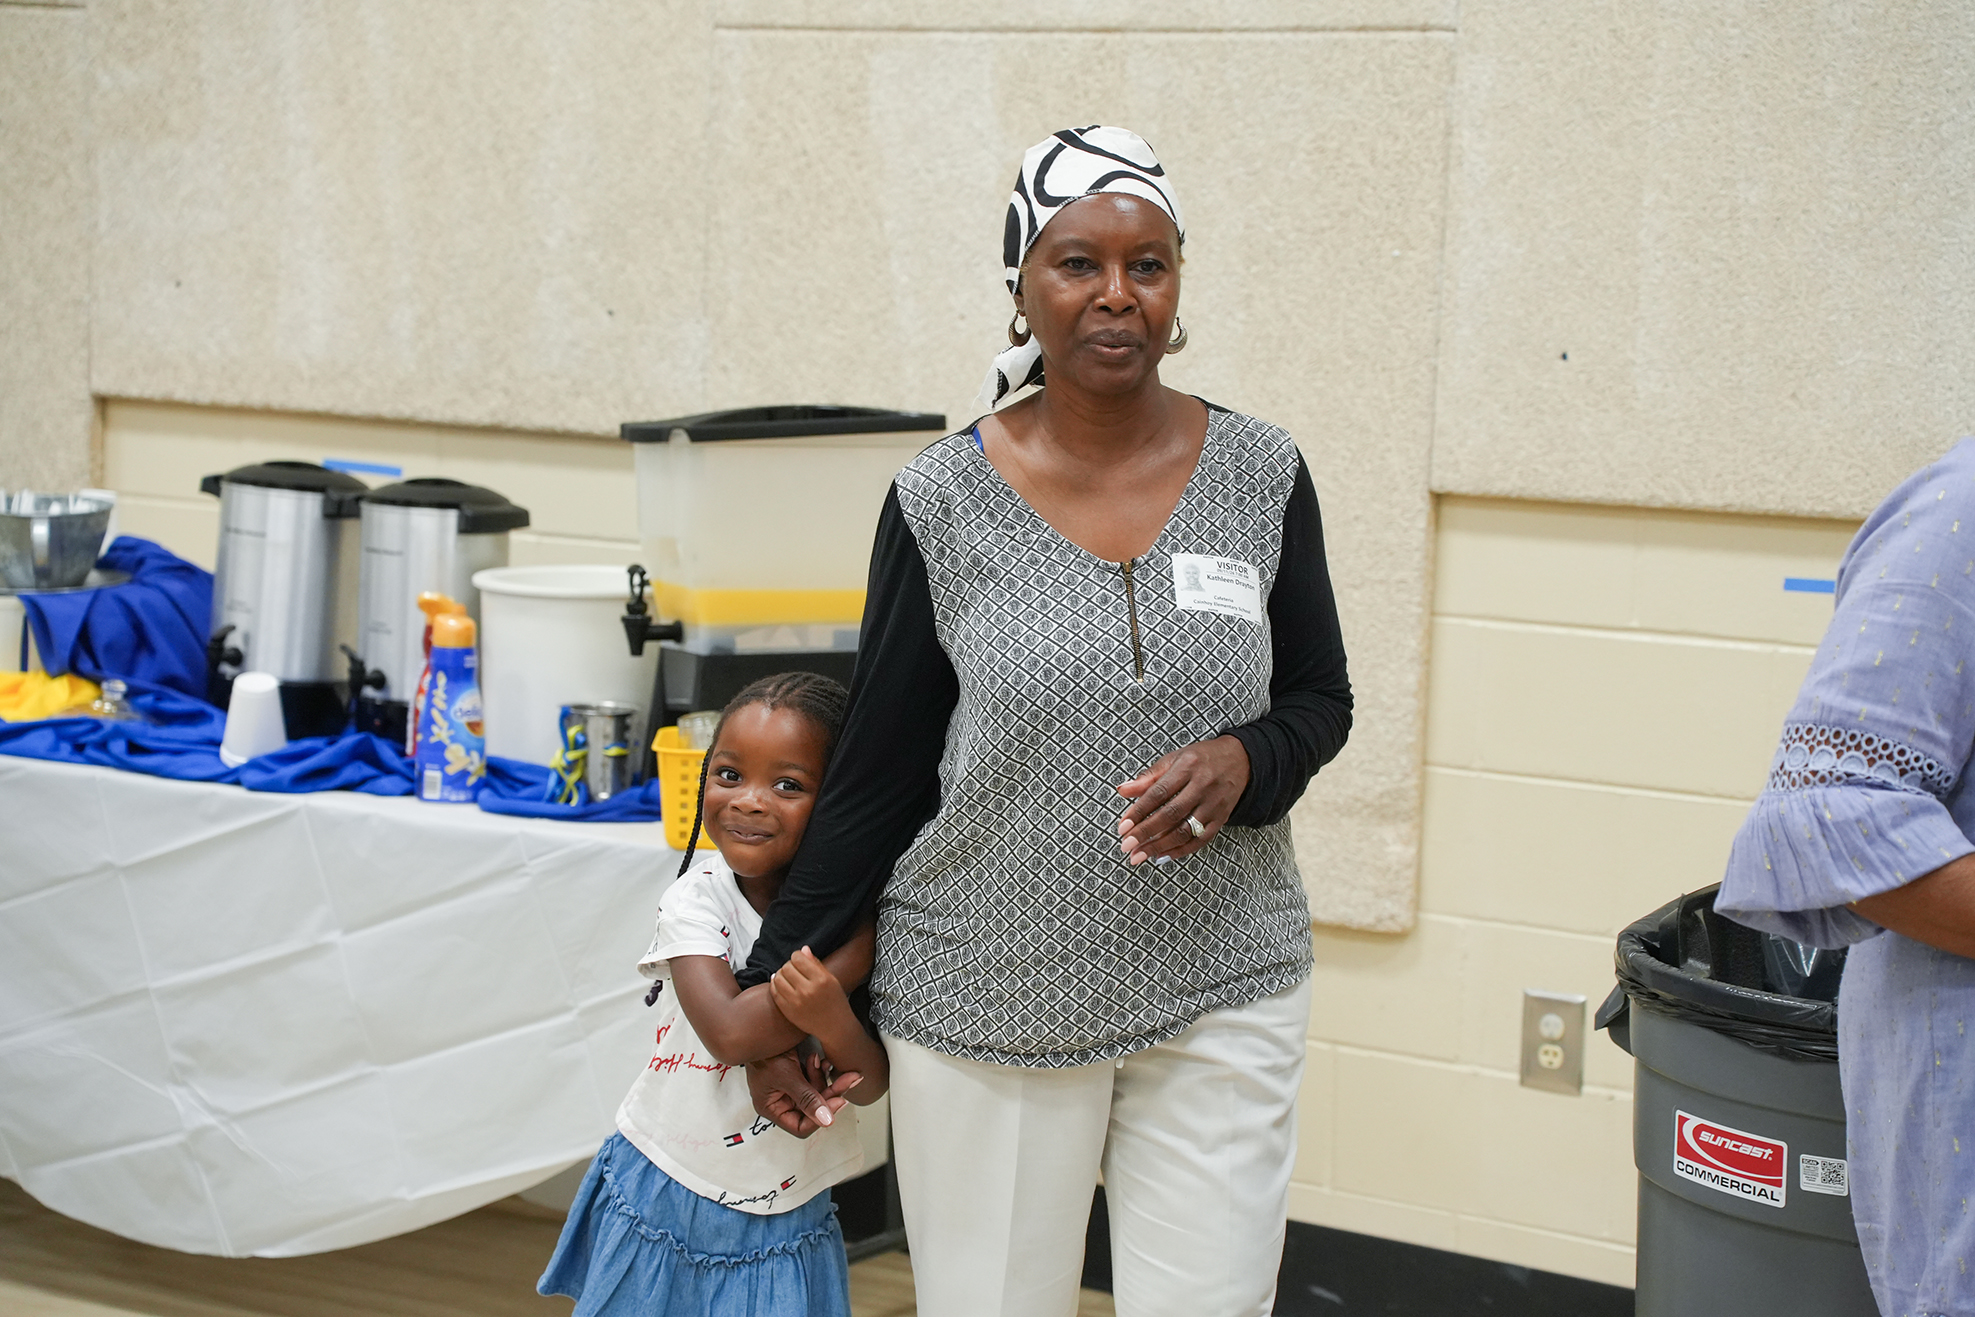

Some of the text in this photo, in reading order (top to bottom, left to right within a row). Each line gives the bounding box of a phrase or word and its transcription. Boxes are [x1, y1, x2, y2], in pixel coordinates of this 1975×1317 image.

[1216, 561, 1249, 575] VISITOR
[1206, 574, 1235, 585] Kathleen
[1676, 1160, 1780, 1202] COMMERCIAL
